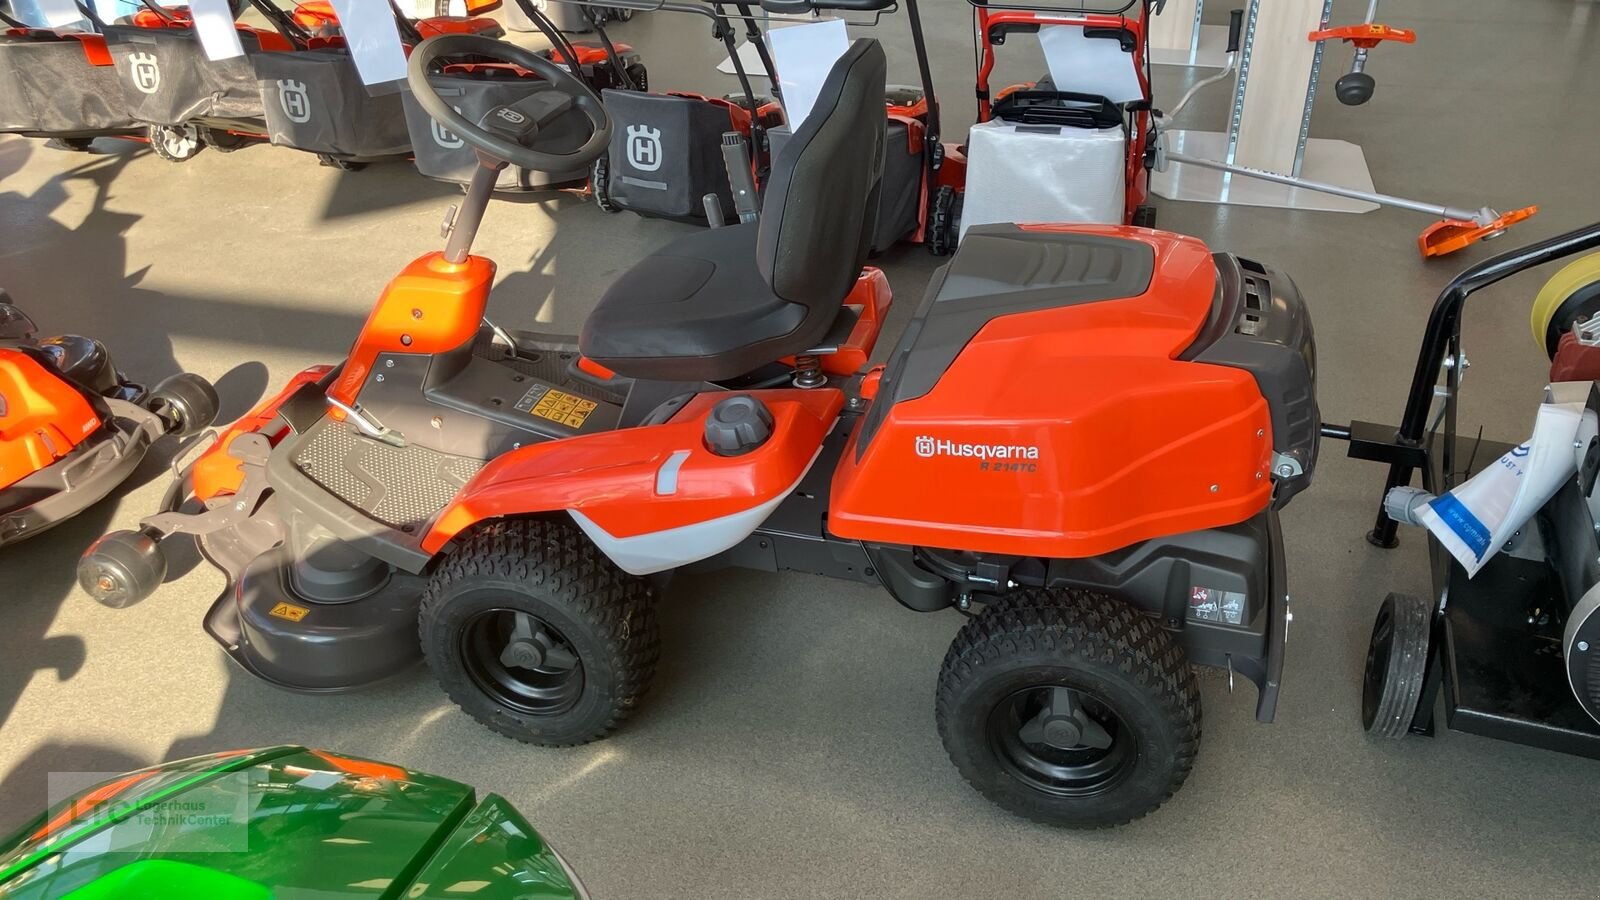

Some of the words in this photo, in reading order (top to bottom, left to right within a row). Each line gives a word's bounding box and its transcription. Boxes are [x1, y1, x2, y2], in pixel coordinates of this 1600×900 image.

[937, 439, 1039, 460] Husqvarna
[980, 461, 990, 471] R
[993, 462, 1037, 473] 214TC
[1500, 456, 1516, 470] UST
